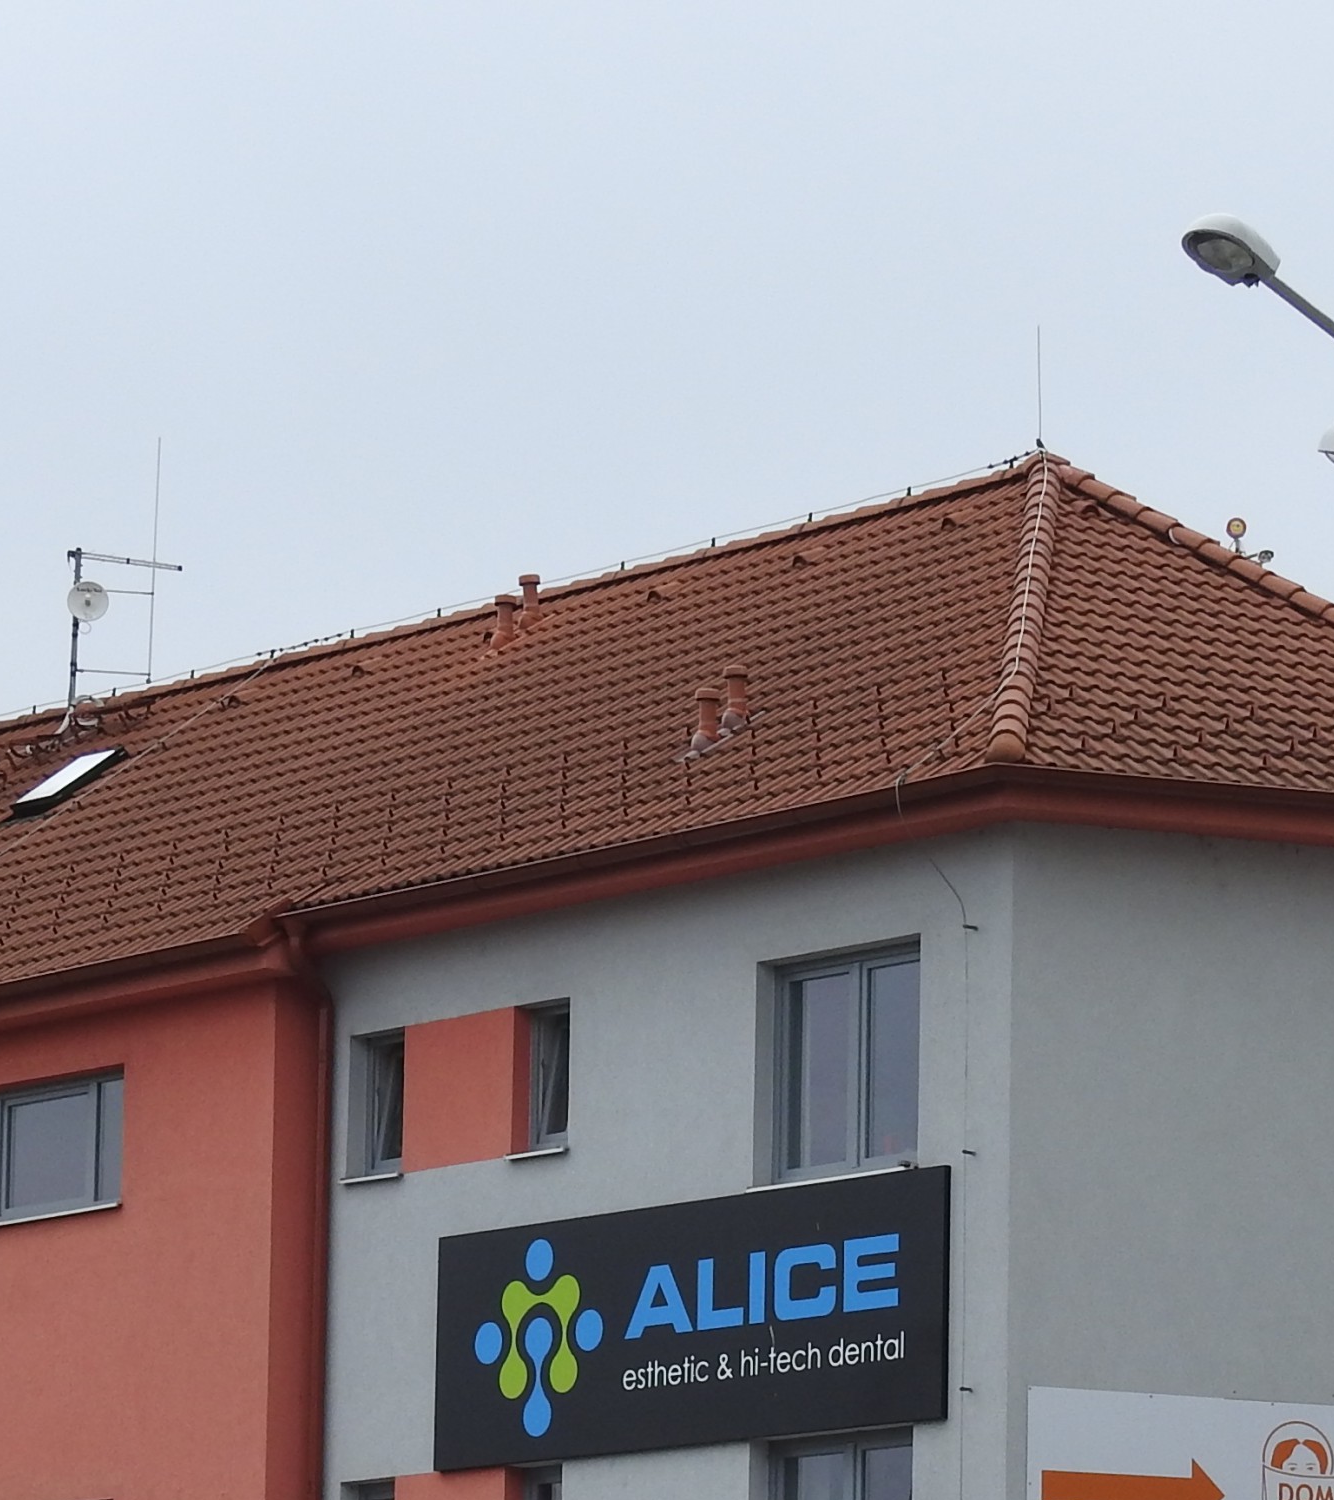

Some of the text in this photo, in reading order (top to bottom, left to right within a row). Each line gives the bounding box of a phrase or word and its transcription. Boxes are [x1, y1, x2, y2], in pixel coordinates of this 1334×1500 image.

[624, 1233, 899, 1340] ALICE
[622, 1330, 905, 1391] esthetic & hi-tech dental
